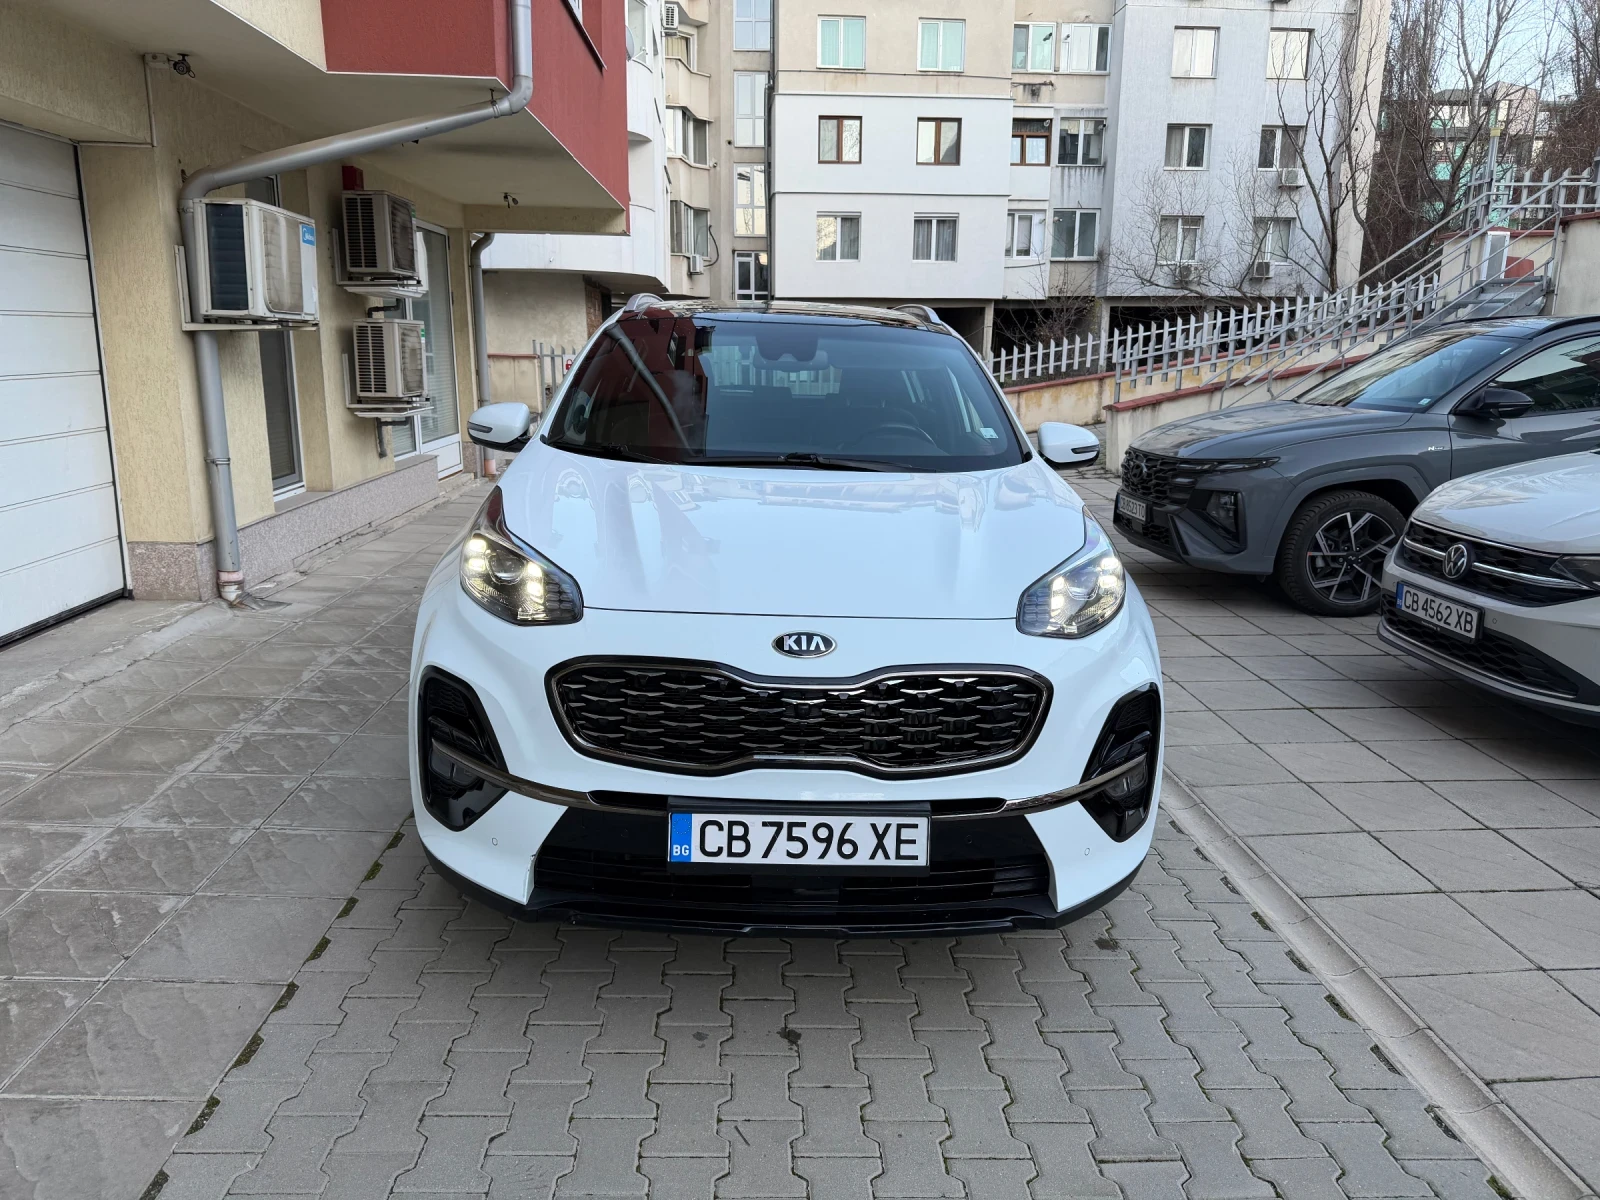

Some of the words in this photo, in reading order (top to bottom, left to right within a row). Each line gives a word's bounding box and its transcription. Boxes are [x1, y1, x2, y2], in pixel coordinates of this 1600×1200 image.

[1404, 590, 1419, 612] CB
[1421, 597, 1452, 627] 4562
[1454, 608, 1473, 634] XB
[783, 635, 826, 651] KIA
[672, 844, 689, 856] BG
[699, 819, 751, 858] CB
[761, 821, 859, 860] 7596
[868, 822, 919, 861] XE
